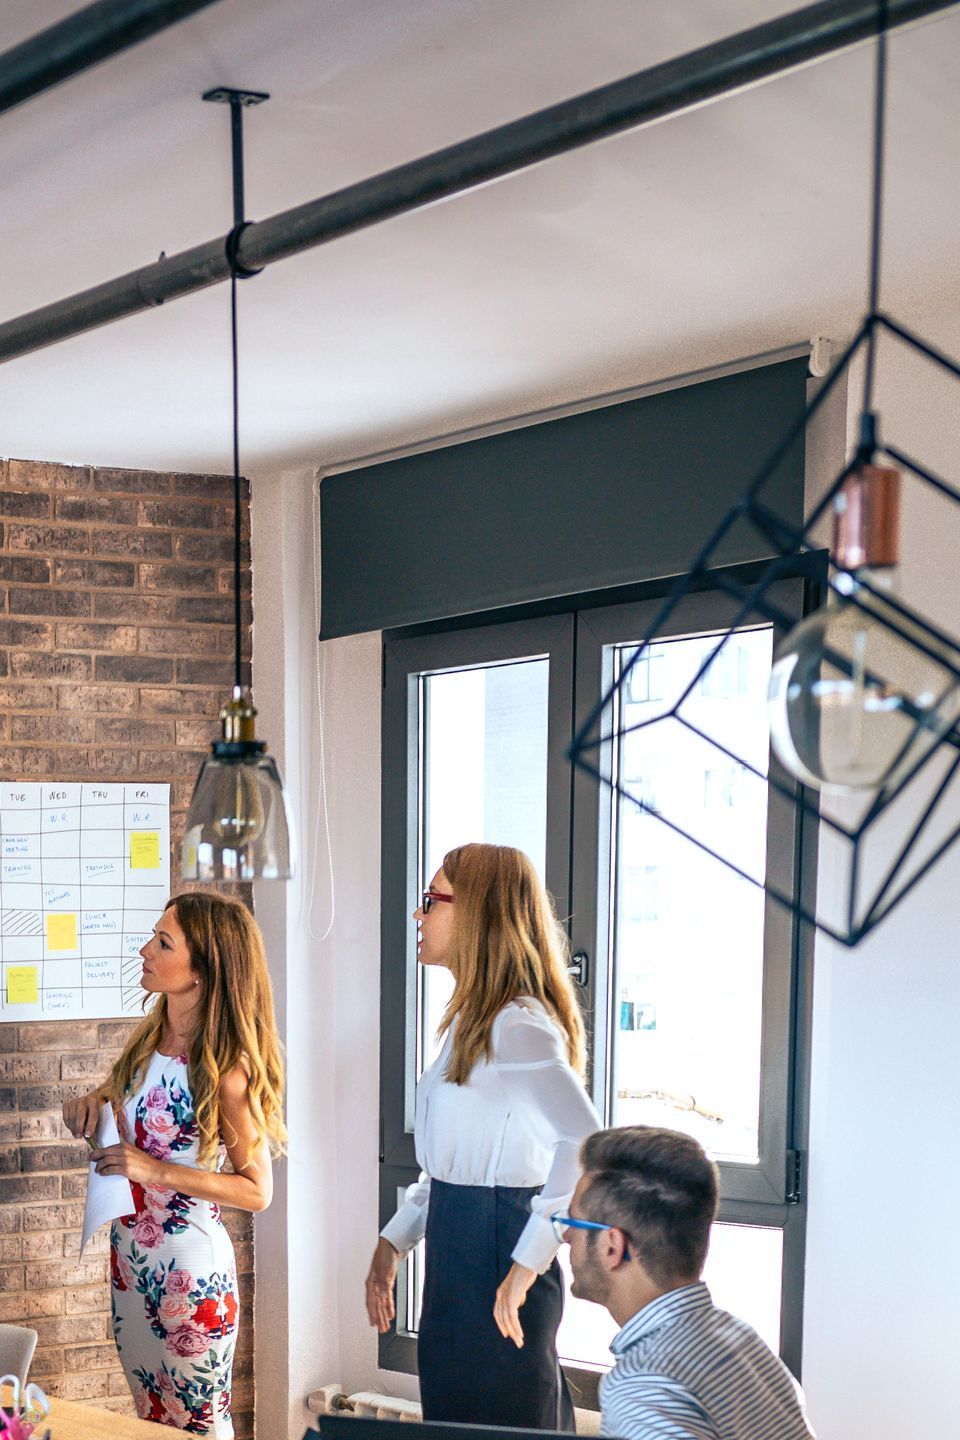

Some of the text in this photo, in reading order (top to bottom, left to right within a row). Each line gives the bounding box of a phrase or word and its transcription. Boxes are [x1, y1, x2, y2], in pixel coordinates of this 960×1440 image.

[49, 792, 67, 800] WED
[92, 791, 108, 799] THU
[135, 791, 149, 799] FRI
[4, 865, 32, 873] TRAINING
[87, 972, 116, 980] DELIVERY
